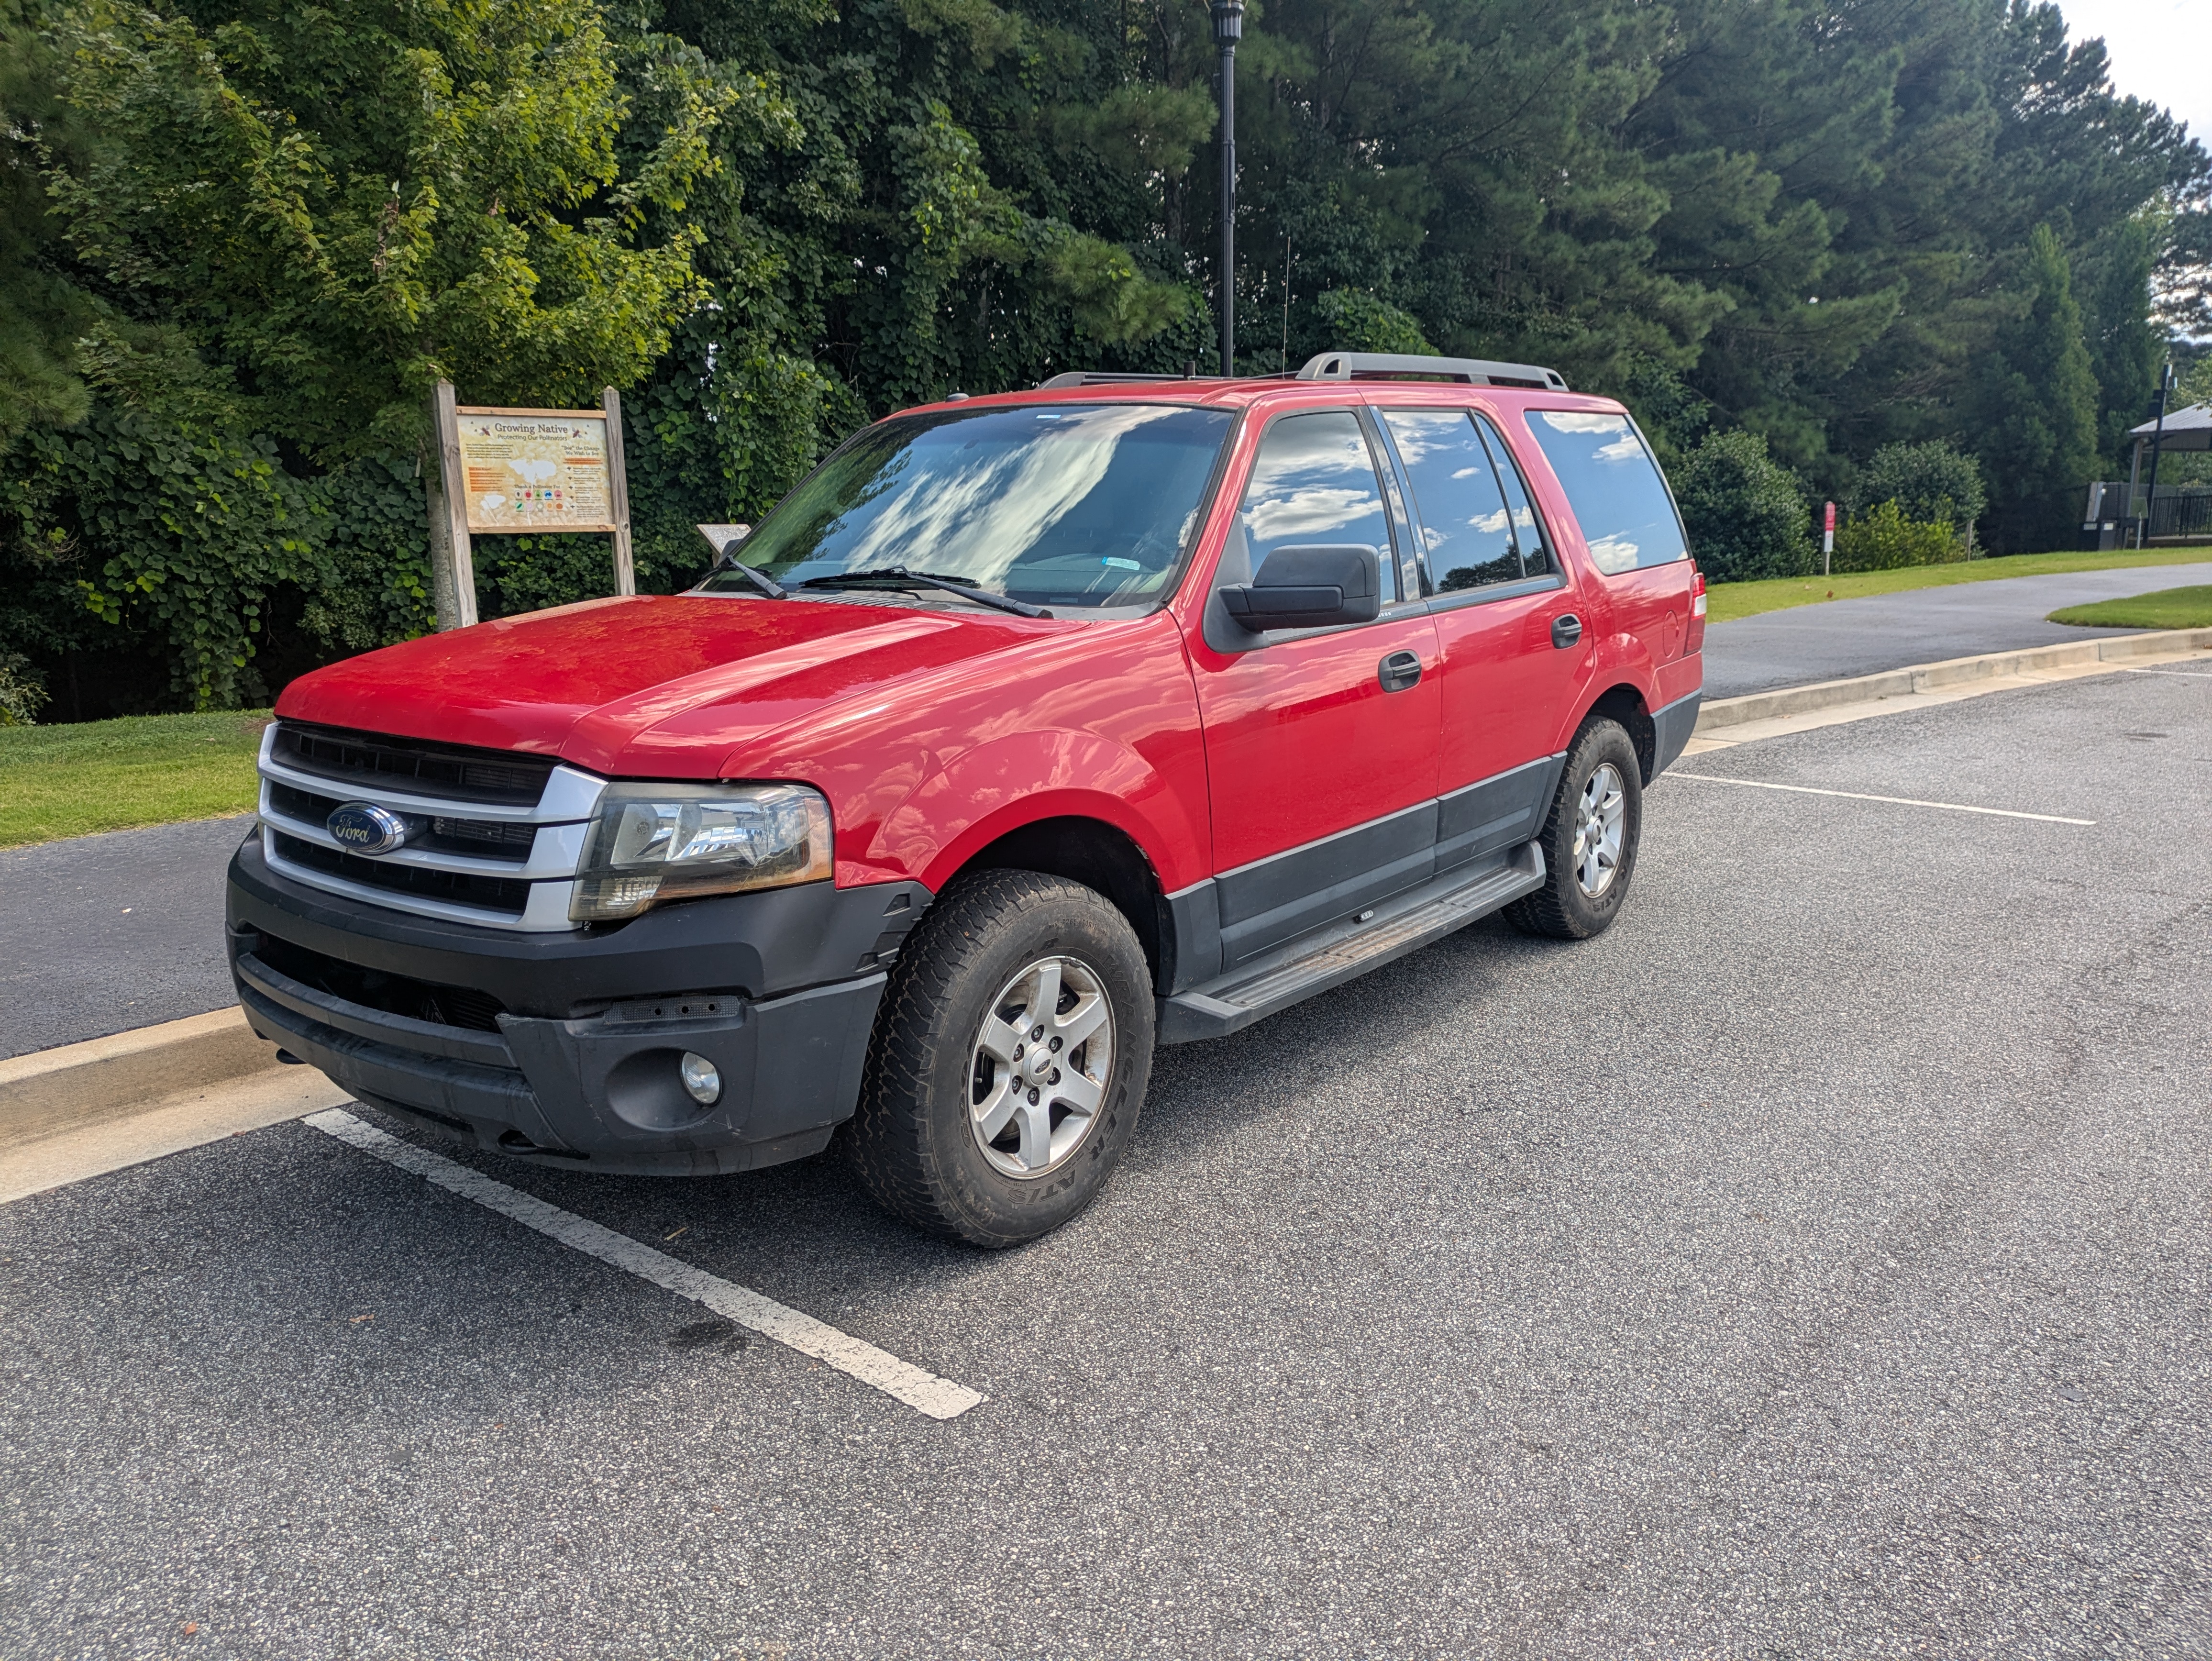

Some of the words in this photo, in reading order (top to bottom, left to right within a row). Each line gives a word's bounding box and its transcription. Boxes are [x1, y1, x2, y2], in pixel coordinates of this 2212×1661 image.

[495, 423, 535, 435] Growing
[538, 424, 568, 433] Native
[336, 814, 371, 843] Ford
[1090, 953, 1137, 1162] WRANGLER
[1007, 1169, 1075, 1206] AT/S
